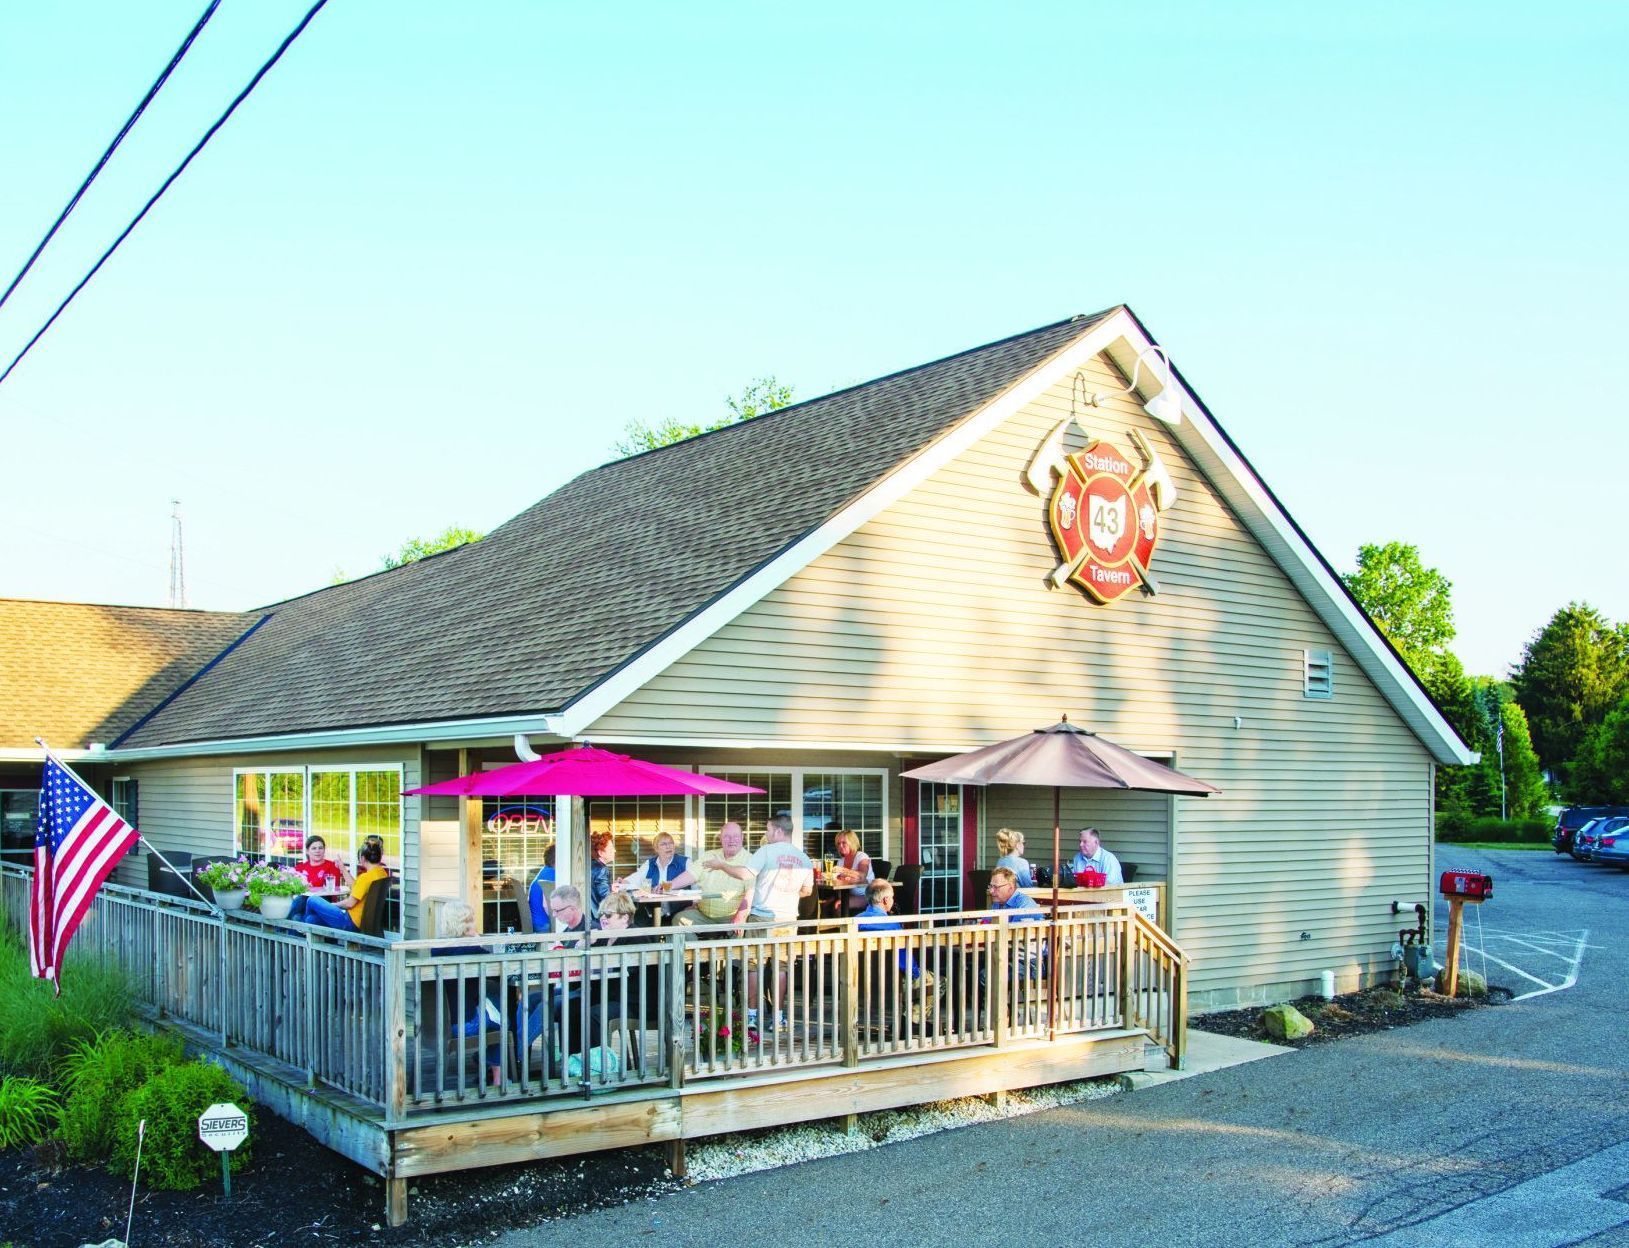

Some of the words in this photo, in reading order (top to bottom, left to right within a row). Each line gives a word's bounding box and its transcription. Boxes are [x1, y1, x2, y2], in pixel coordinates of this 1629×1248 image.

[1084, 453, 1128, 474] Station
[1094, 505, 1119, 535] 43
[1089, 564, 1130, 584] Tavern
[492, 814, 554, 834] OPEN
[201, 1119, 246, 1130] SIEVERS
